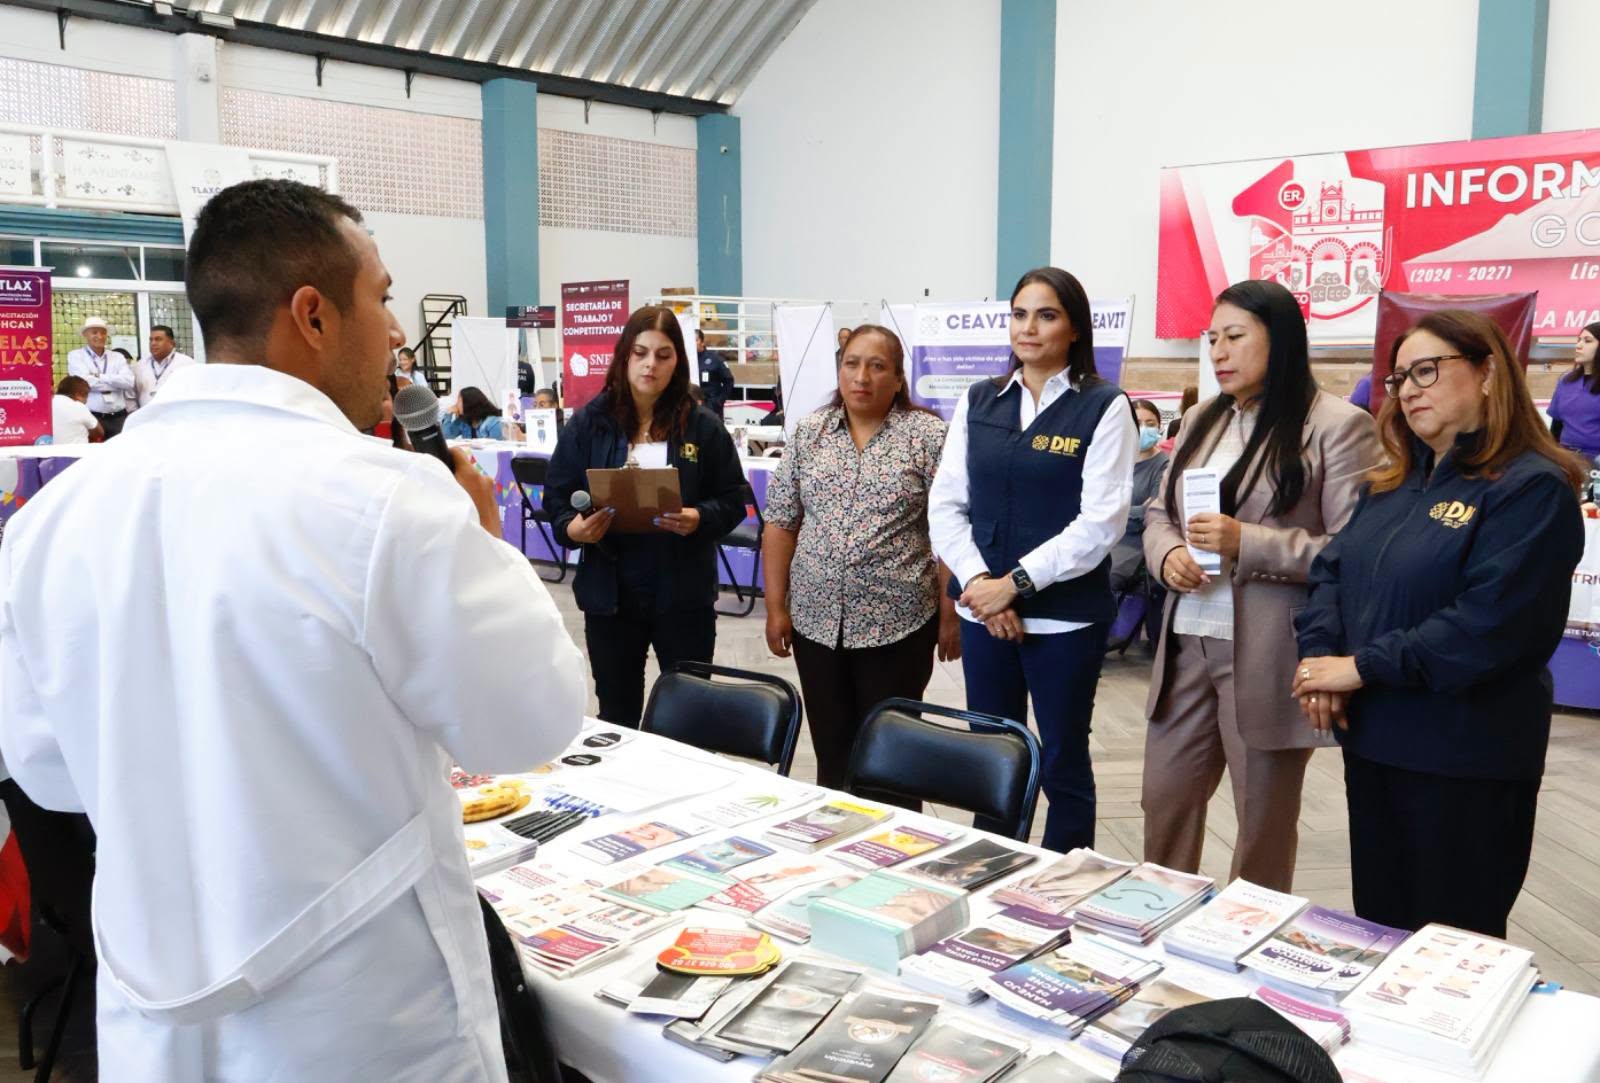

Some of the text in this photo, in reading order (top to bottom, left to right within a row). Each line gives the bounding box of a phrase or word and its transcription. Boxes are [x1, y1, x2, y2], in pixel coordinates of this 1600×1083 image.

[1531, 211, 1600, 248] GO
[1410, 267, 1452, 282] (2024
[1467, 266, 1512, 281] 2027)
[566, 299, 622, 312] SECRETARÍA DE
[1, 320, 33, 329] HCAN
[574, 313, 613, 323] TRABAJO Y
[1050, 435, 1080, 452] DIF
[1004, 981, 1052, 1006] MANEJO
